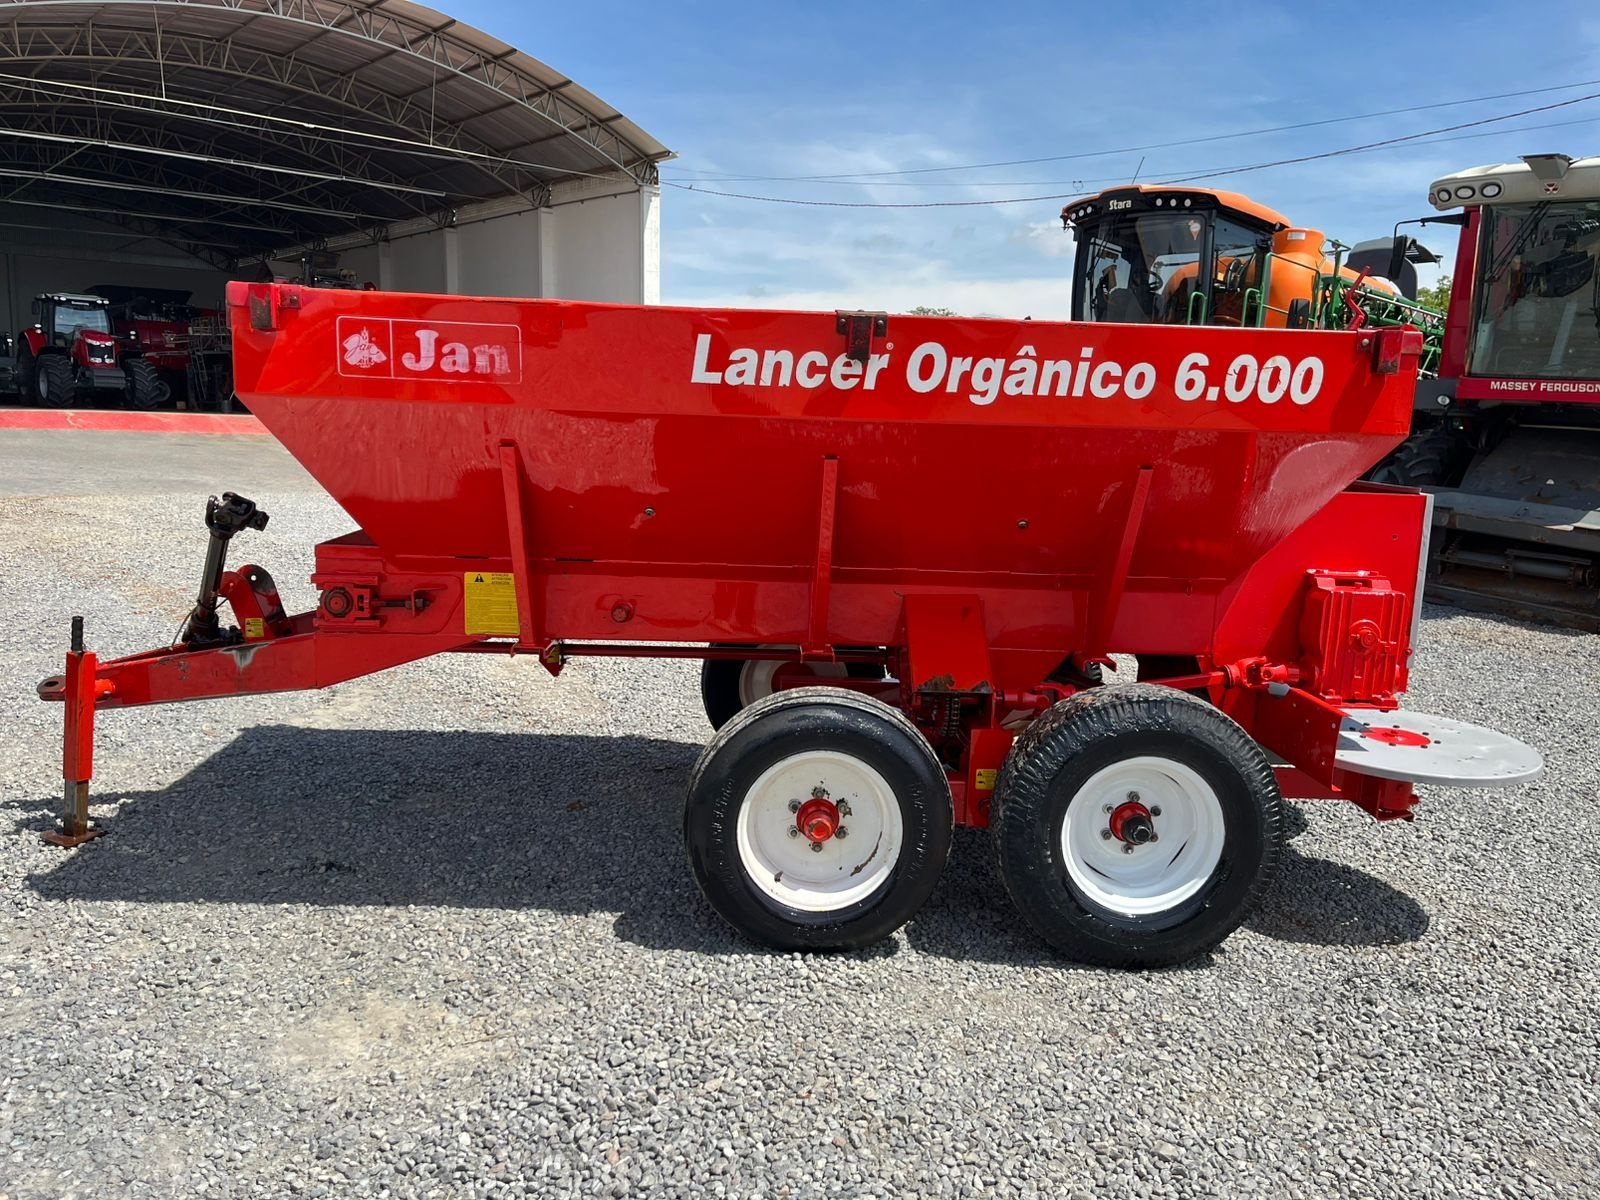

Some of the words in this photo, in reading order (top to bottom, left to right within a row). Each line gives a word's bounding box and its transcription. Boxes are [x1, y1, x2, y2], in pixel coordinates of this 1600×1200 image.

[1109, 200, 1132, 210] Stara
[402, 329, 511, 375] Jan
[691, 333, 890, 390] Lancer
[906, 341, 1157, 405] Orgânico
[1174, 352, 1324, 405] 6.000
[1490, 381, 1536, 391] MASSEY
